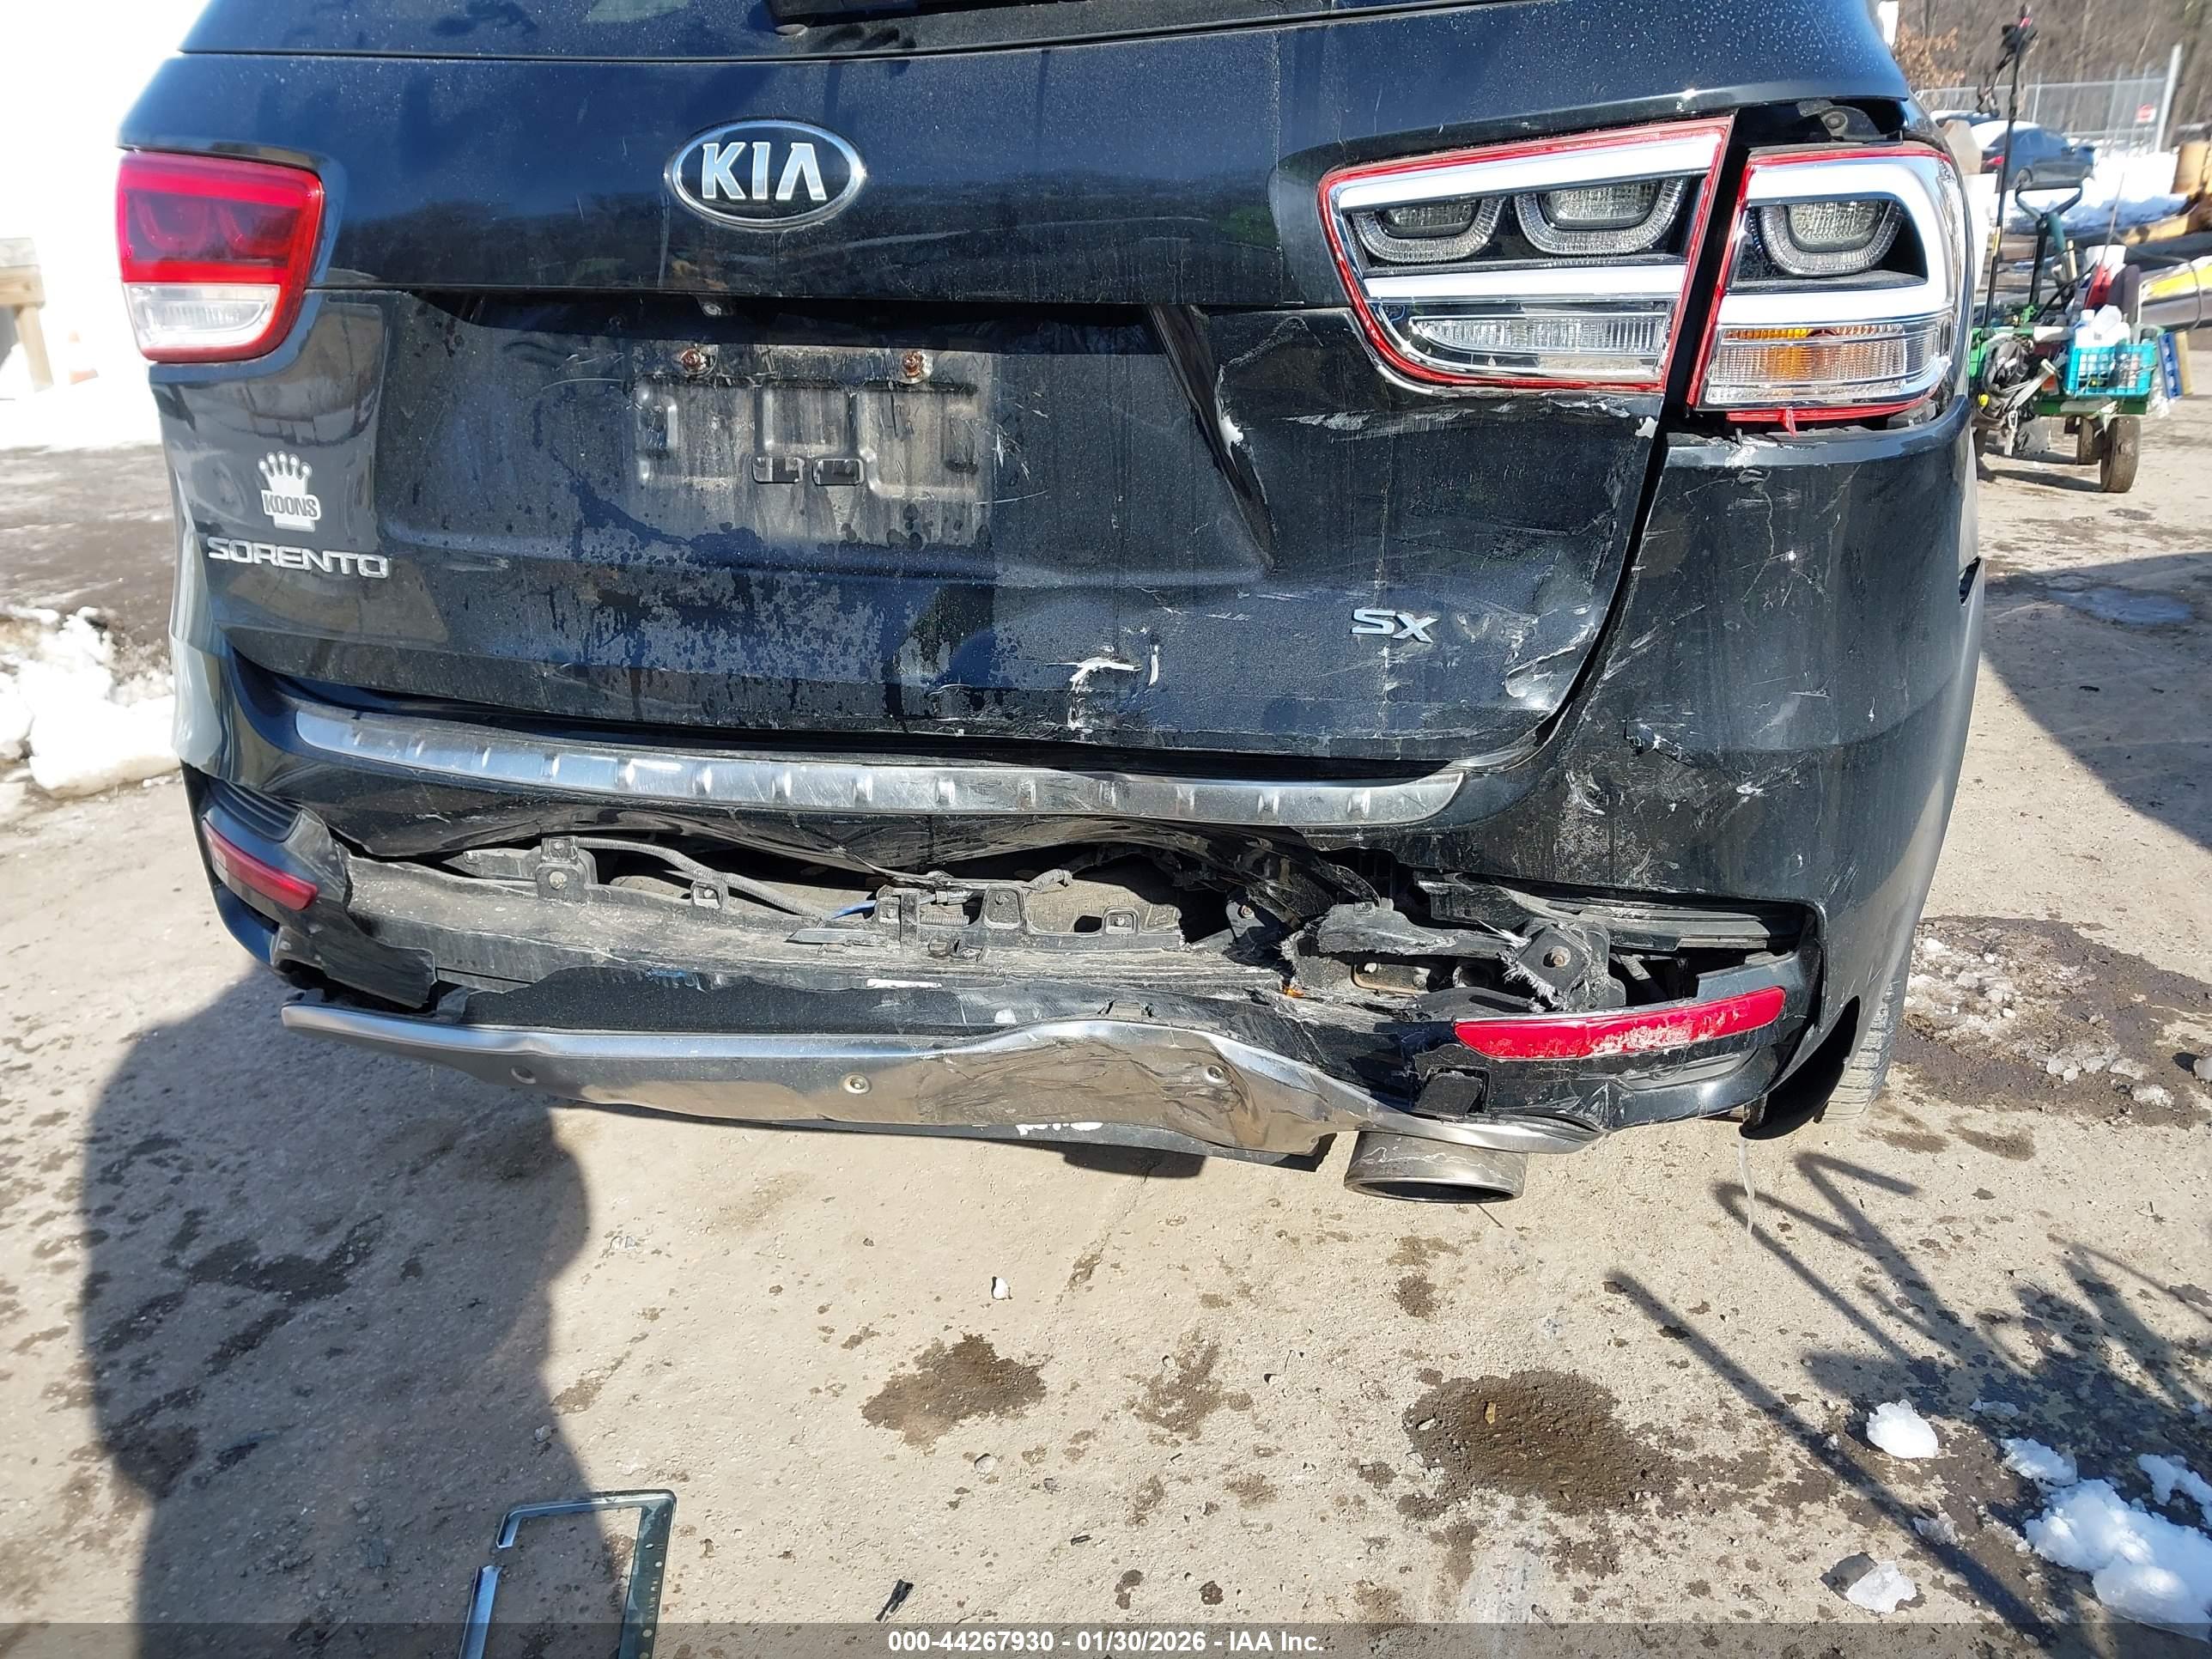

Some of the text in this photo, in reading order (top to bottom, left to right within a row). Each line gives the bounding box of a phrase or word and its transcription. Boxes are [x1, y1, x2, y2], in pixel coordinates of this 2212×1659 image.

[701, 141, 828, 201] KIA
[262, 493, 319, 518] KOONS
[206, 536, 389, 580] SORENTO
[1351, 609, 1438, 643] SX
